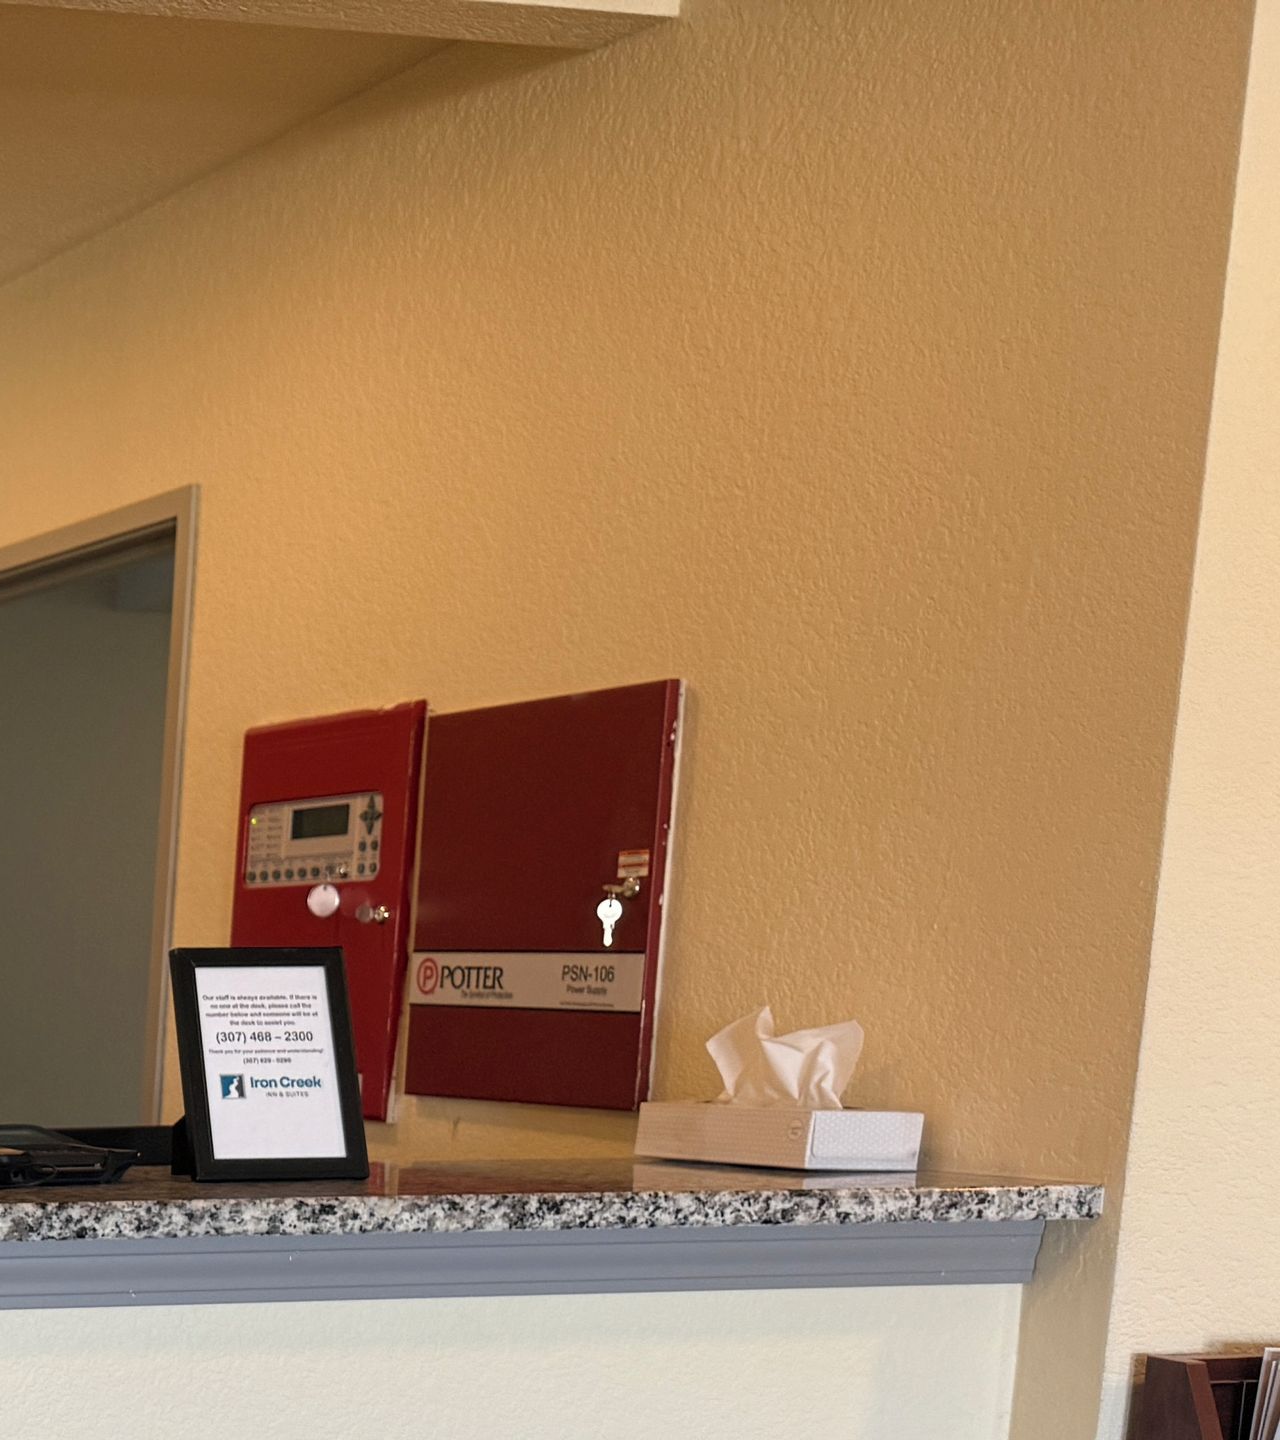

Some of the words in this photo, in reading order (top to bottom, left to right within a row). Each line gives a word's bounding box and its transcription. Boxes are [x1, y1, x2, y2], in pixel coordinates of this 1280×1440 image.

[439, 965, 504, 990] POTTER
[561, 964, 615, 982] PSN-106
[216, 1031, 247, 1045] (307)
[249, 1031, 272, 1042] 468
[284, 1031, 313, 1042] 2300
[250, 1076, 278, 1088] Iron
[279, 1075, 321, 1088] Creek
